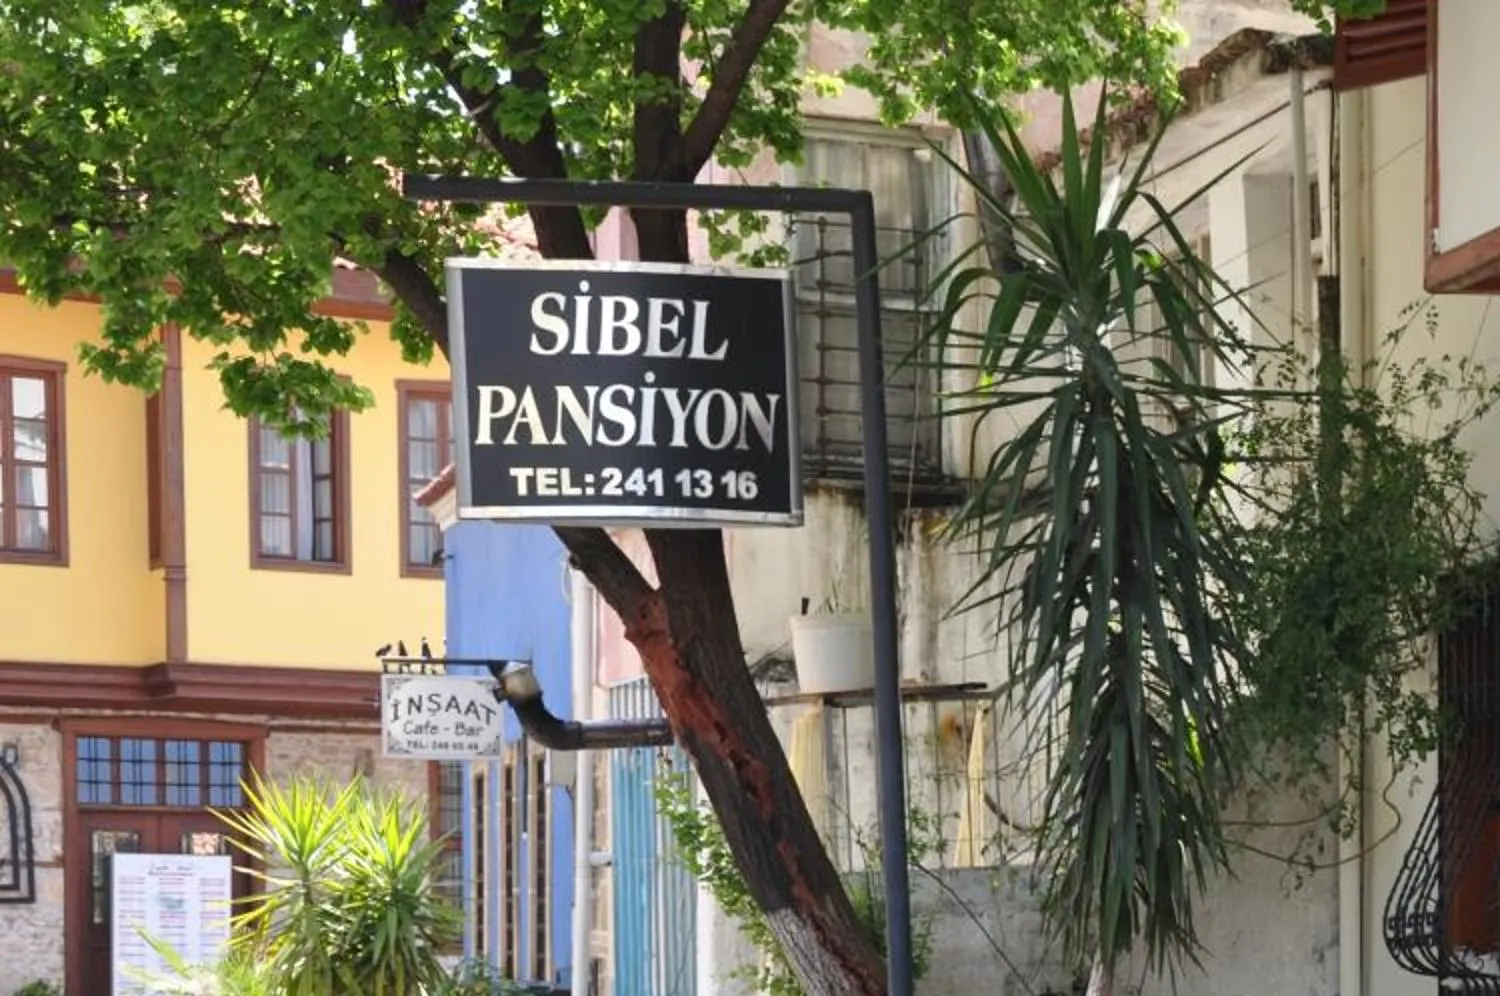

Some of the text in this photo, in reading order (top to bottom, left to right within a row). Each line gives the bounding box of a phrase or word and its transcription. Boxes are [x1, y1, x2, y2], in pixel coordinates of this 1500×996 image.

[529, 279, 729, 361] SİBEL
[474, 371, 780, 455] PANSİYON
[509, 467, 760, 500] TEL: 241 13 16
[403, 720, 439, 735] Cafe
[454, 721, 485, 737] Bar
